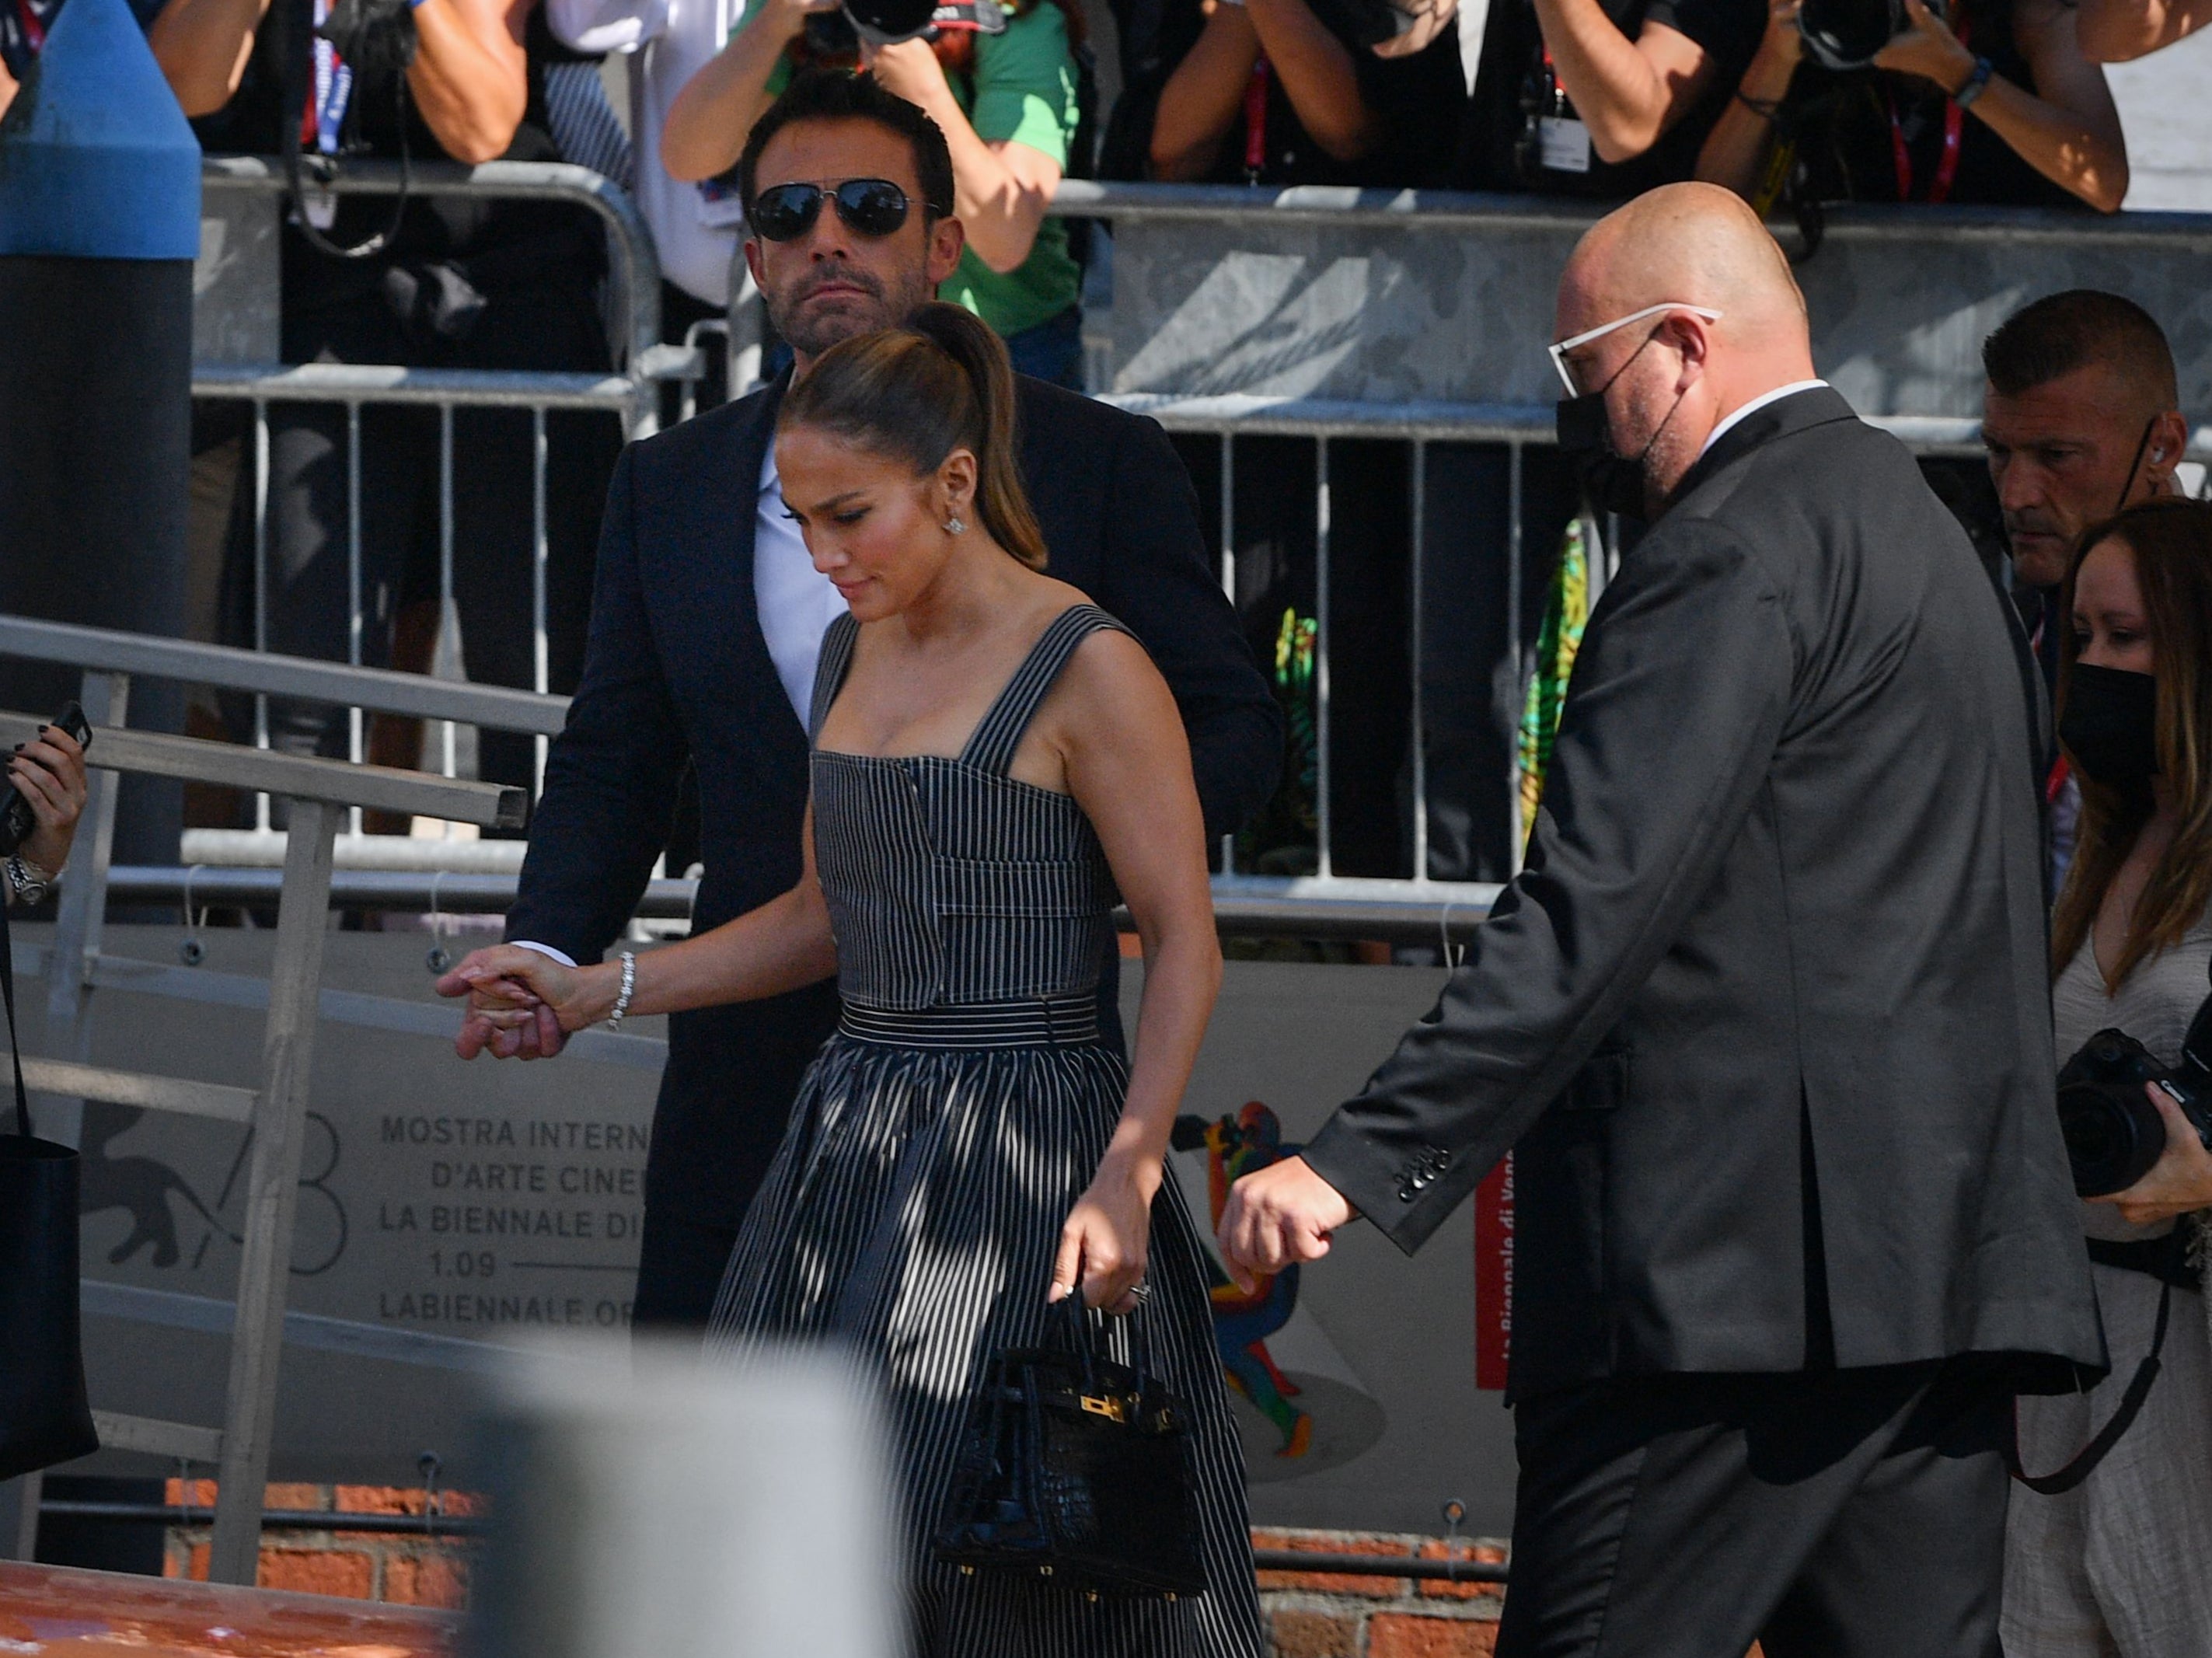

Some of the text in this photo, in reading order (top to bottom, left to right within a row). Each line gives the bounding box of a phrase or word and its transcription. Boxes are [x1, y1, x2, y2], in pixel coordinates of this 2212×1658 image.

[382, 1115, 648, 1150] MOSTRA INTERN
[431, 1161, 546, 1192] D'ARTE
[379, 1203, 637, 1239] LA BIENNALE DI
[430, 1251, 496, 1278] 1.09
